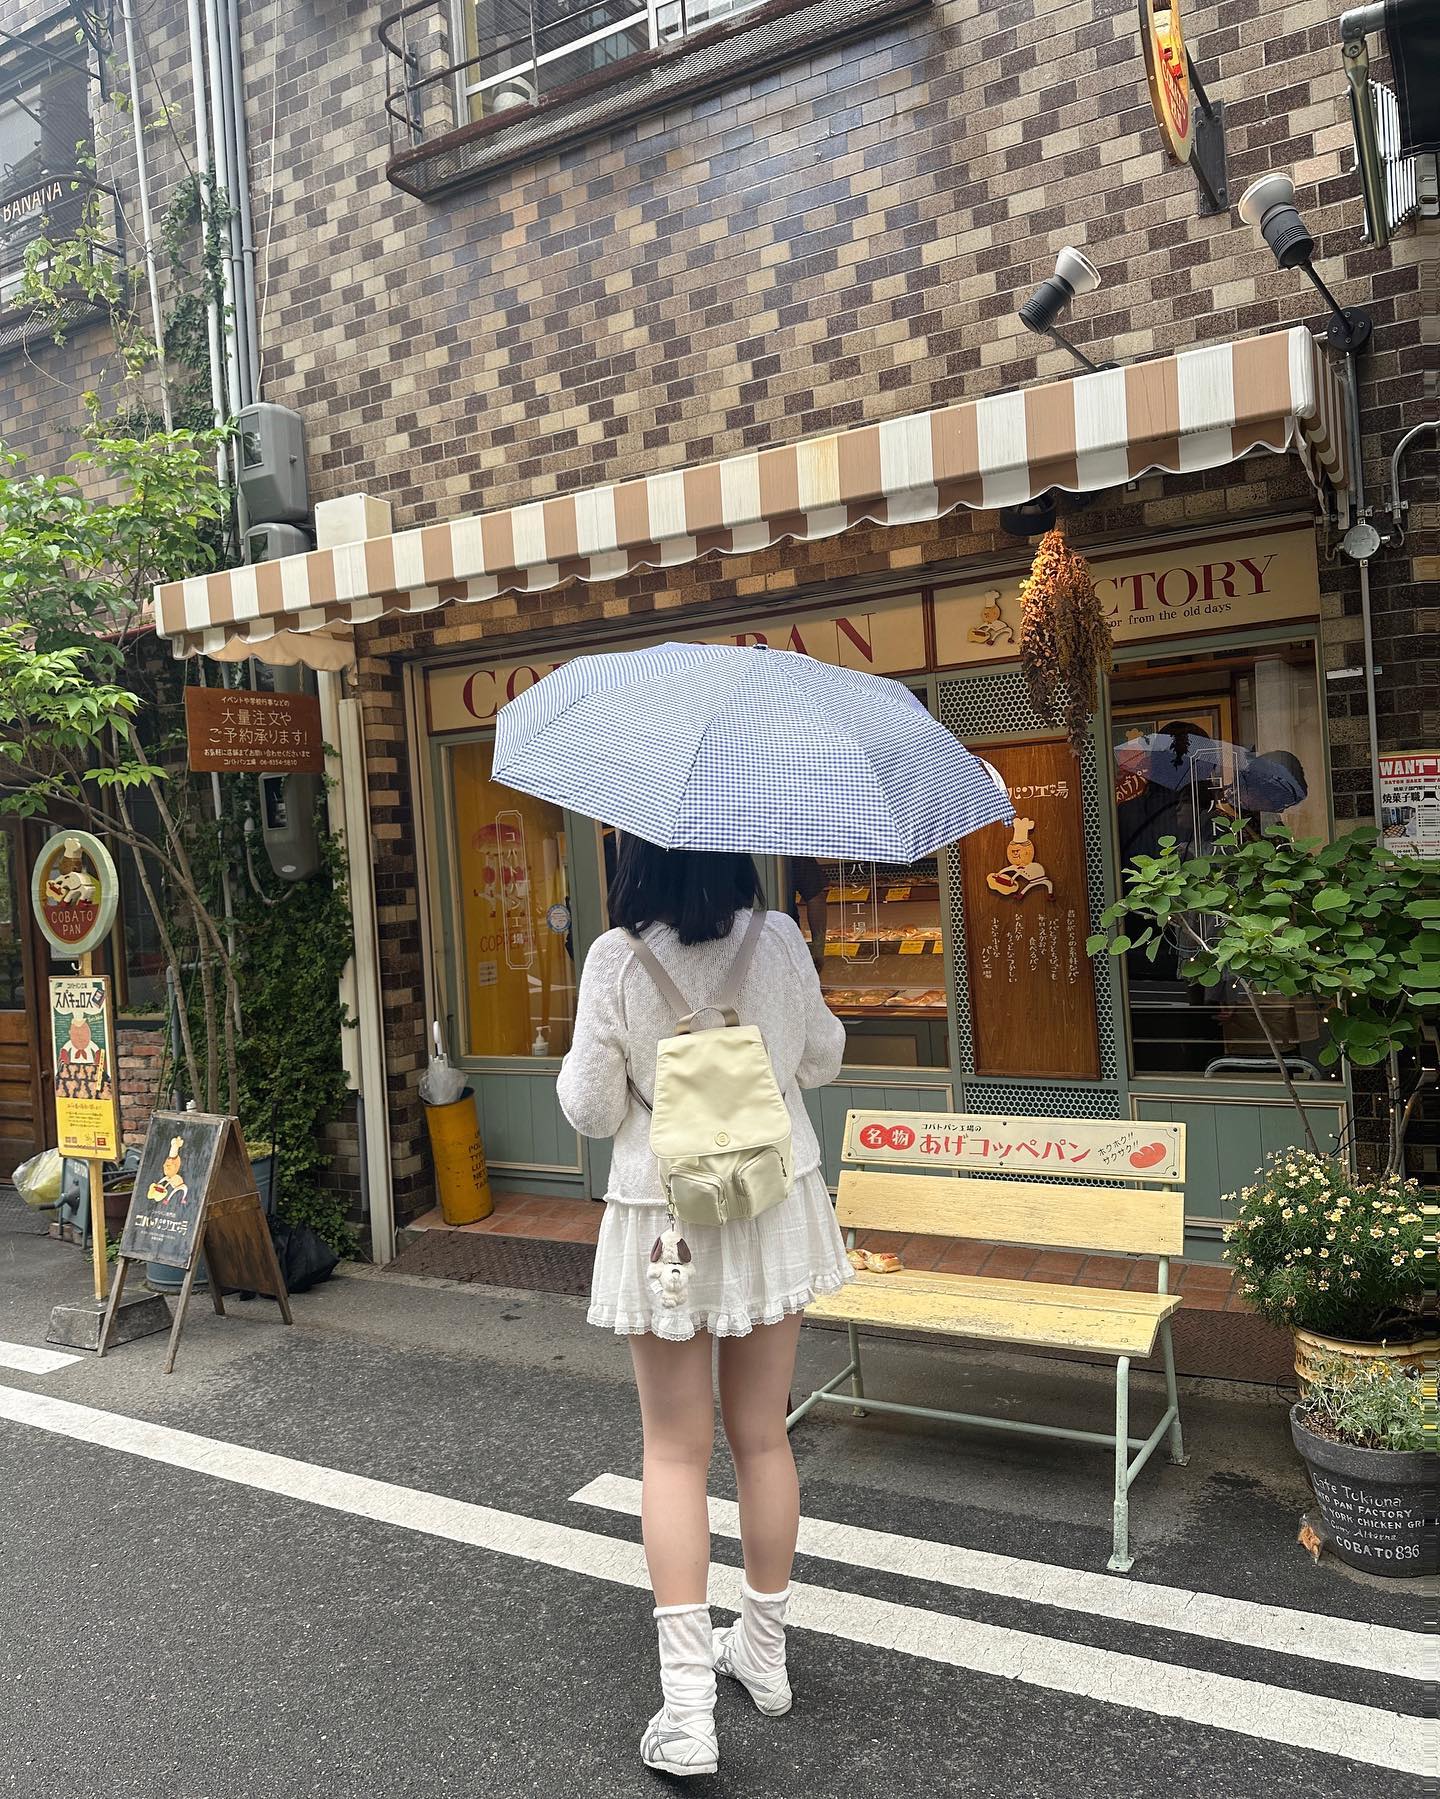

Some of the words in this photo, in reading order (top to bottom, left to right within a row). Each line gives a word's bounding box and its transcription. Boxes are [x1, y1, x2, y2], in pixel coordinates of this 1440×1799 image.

[3, 181, 63, 223] BANANA
[1090, 554, 1279, 617] CTORY
[1129, 614, 1155, 626] from
[1159, 610, 1177, 620] the
[1183, 605, 1200, 617] old
[1204, 603, 1231, 615] days
[221, 708, 292, 727] 大量注文や
[51, 910, 93, 924] COBATO
[62, 924, 81, 936] PAN
[866, 1127, 909, 1146] 名物
[921, 1123, 982, 1132] コバトパン工場の
[919, 1132, 1091, 1163] あげコッペパン
[1333, 1498, 1353, 1511] PAN
[1358, 1506, 1412, 1518] FACTORY
[1329, 1508, 1354, 1523] YORK
[1357, 1518, 1402, 1530] CHICKEN
